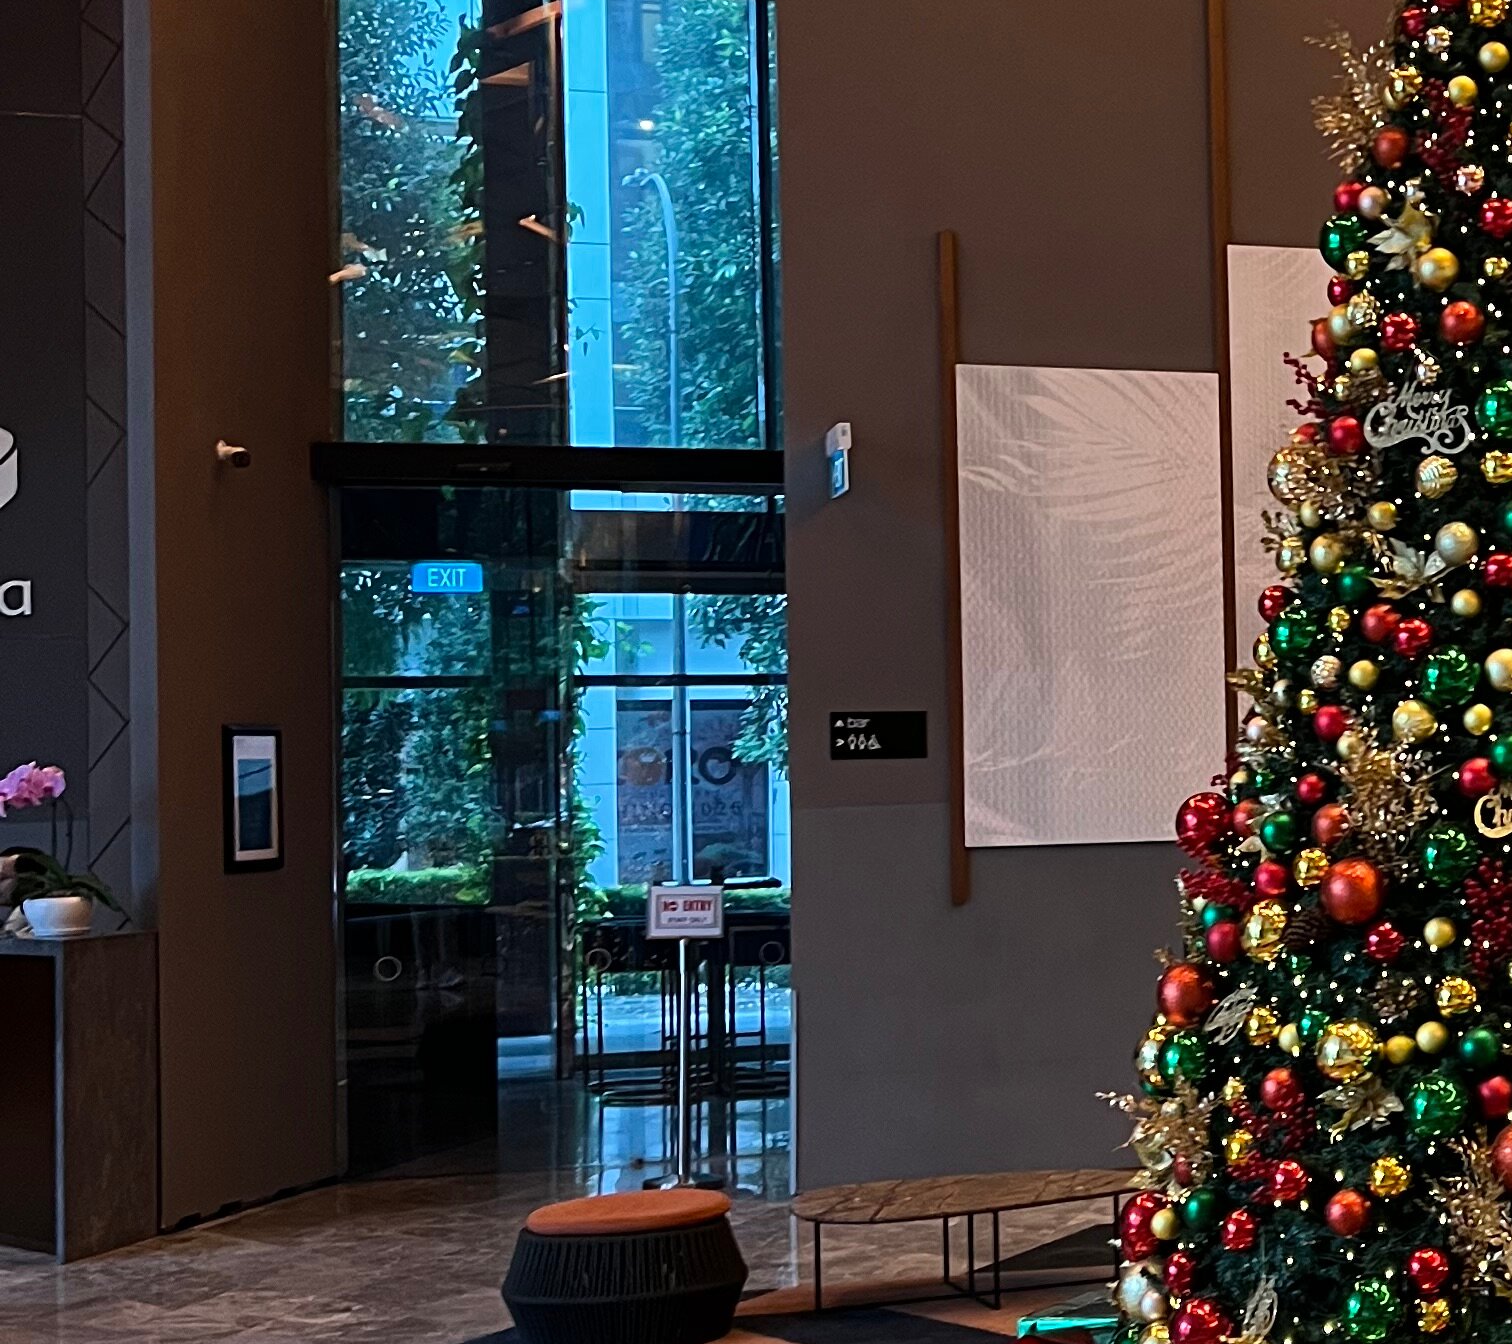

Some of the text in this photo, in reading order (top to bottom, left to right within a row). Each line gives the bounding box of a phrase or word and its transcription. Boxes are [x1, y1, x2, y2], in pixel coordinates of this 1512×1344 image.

[427, 567, 467, 587] EXIT
[663, 899, 713, 912] NO ENTRY
